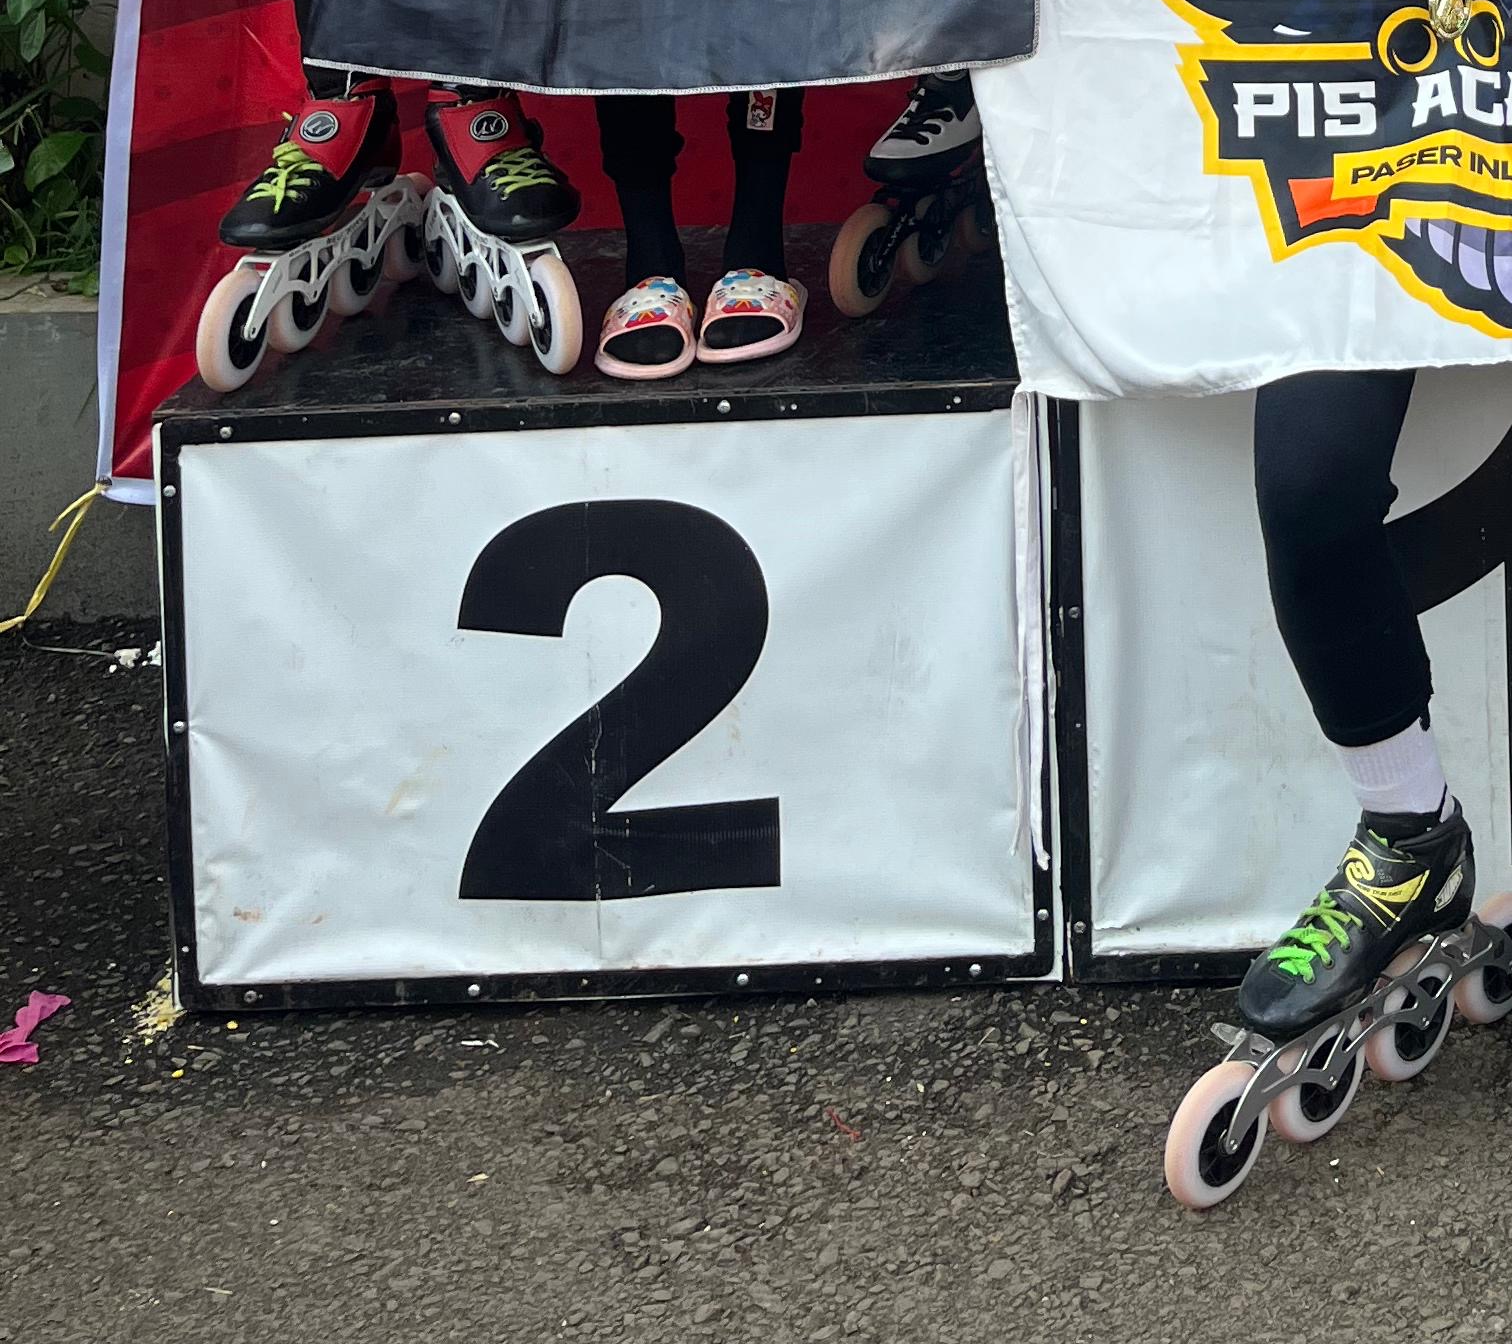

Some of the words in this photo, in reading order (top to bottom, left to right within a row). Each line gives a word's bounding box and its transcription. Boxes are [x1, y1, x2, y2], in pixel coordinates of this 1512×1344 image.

[1233, 80, 1378, 139] PIS
[1350, 145, 1463, 185] PASER
[455, 498, 782, 902] 2
